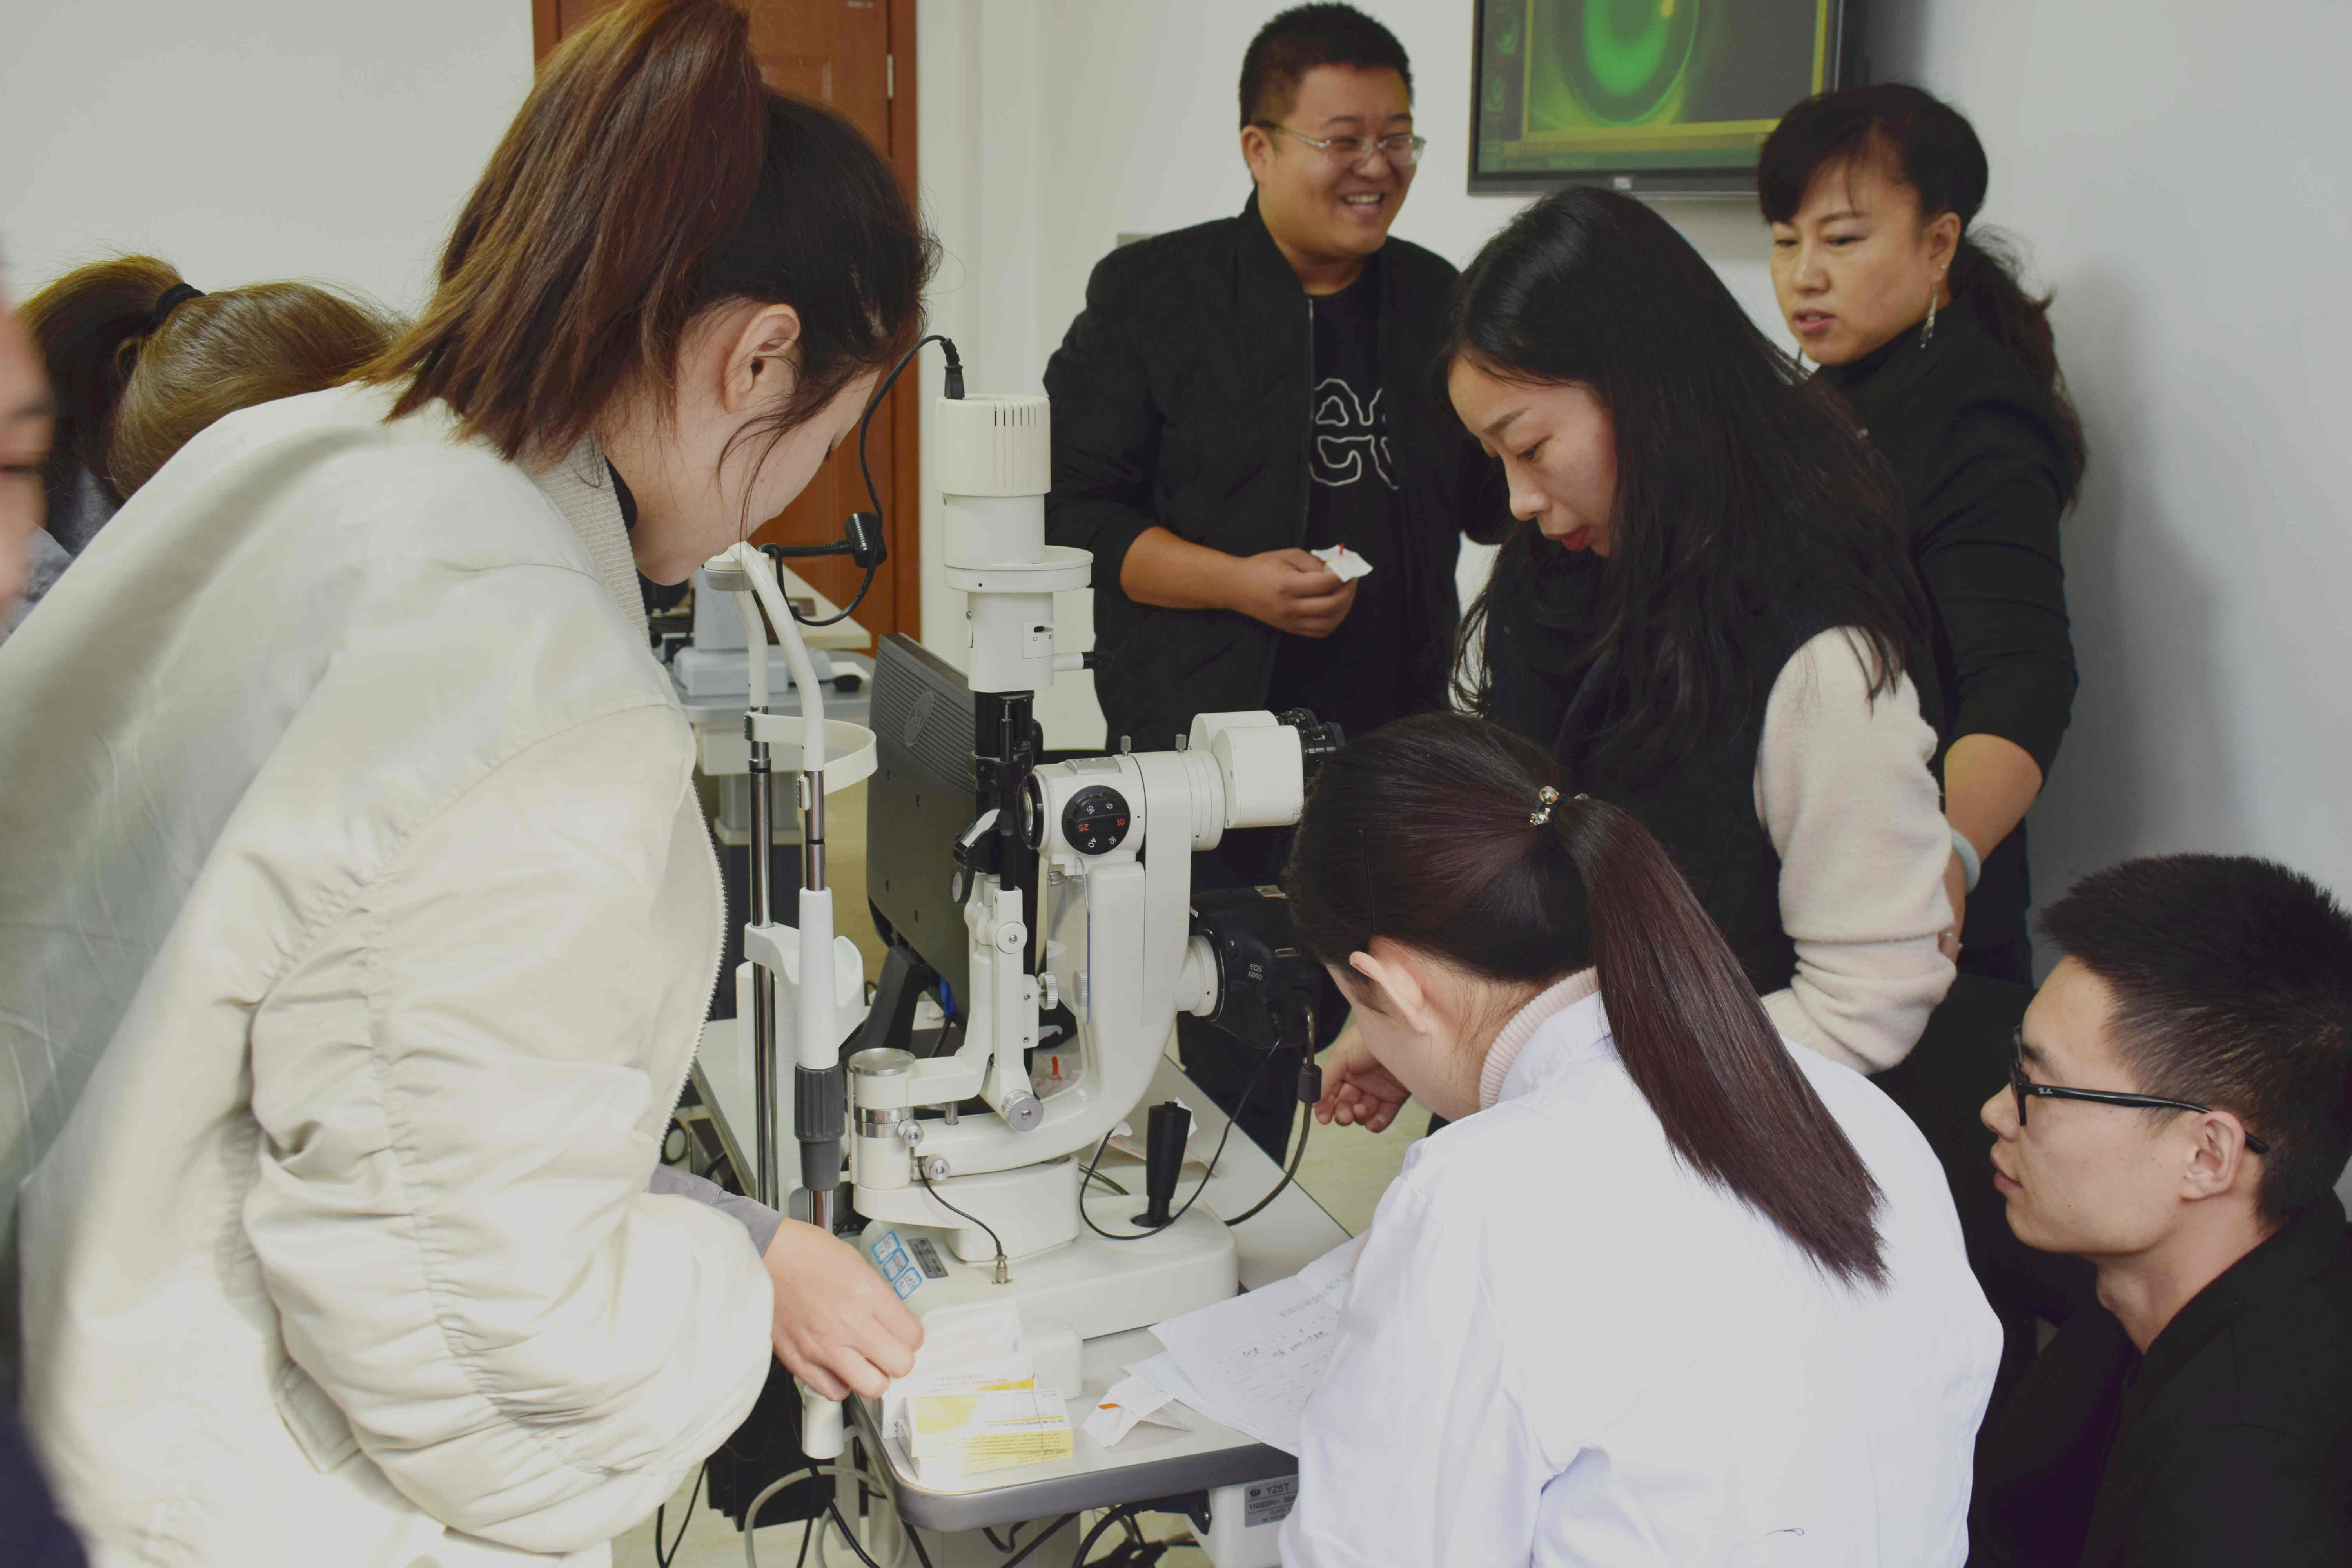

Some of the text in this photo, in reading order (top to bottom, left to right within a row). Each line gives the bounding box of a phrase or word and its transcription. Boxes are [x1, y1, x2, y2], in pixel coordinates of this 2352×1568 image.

[1117, 818, 1125, 826] 10
[1088, 837, 1096, 848] 40
[1109, 836, 1116, 844] 16
[1250, 963, 1263, 972] EOS
[1248, 971, 1263, 980] 600D
